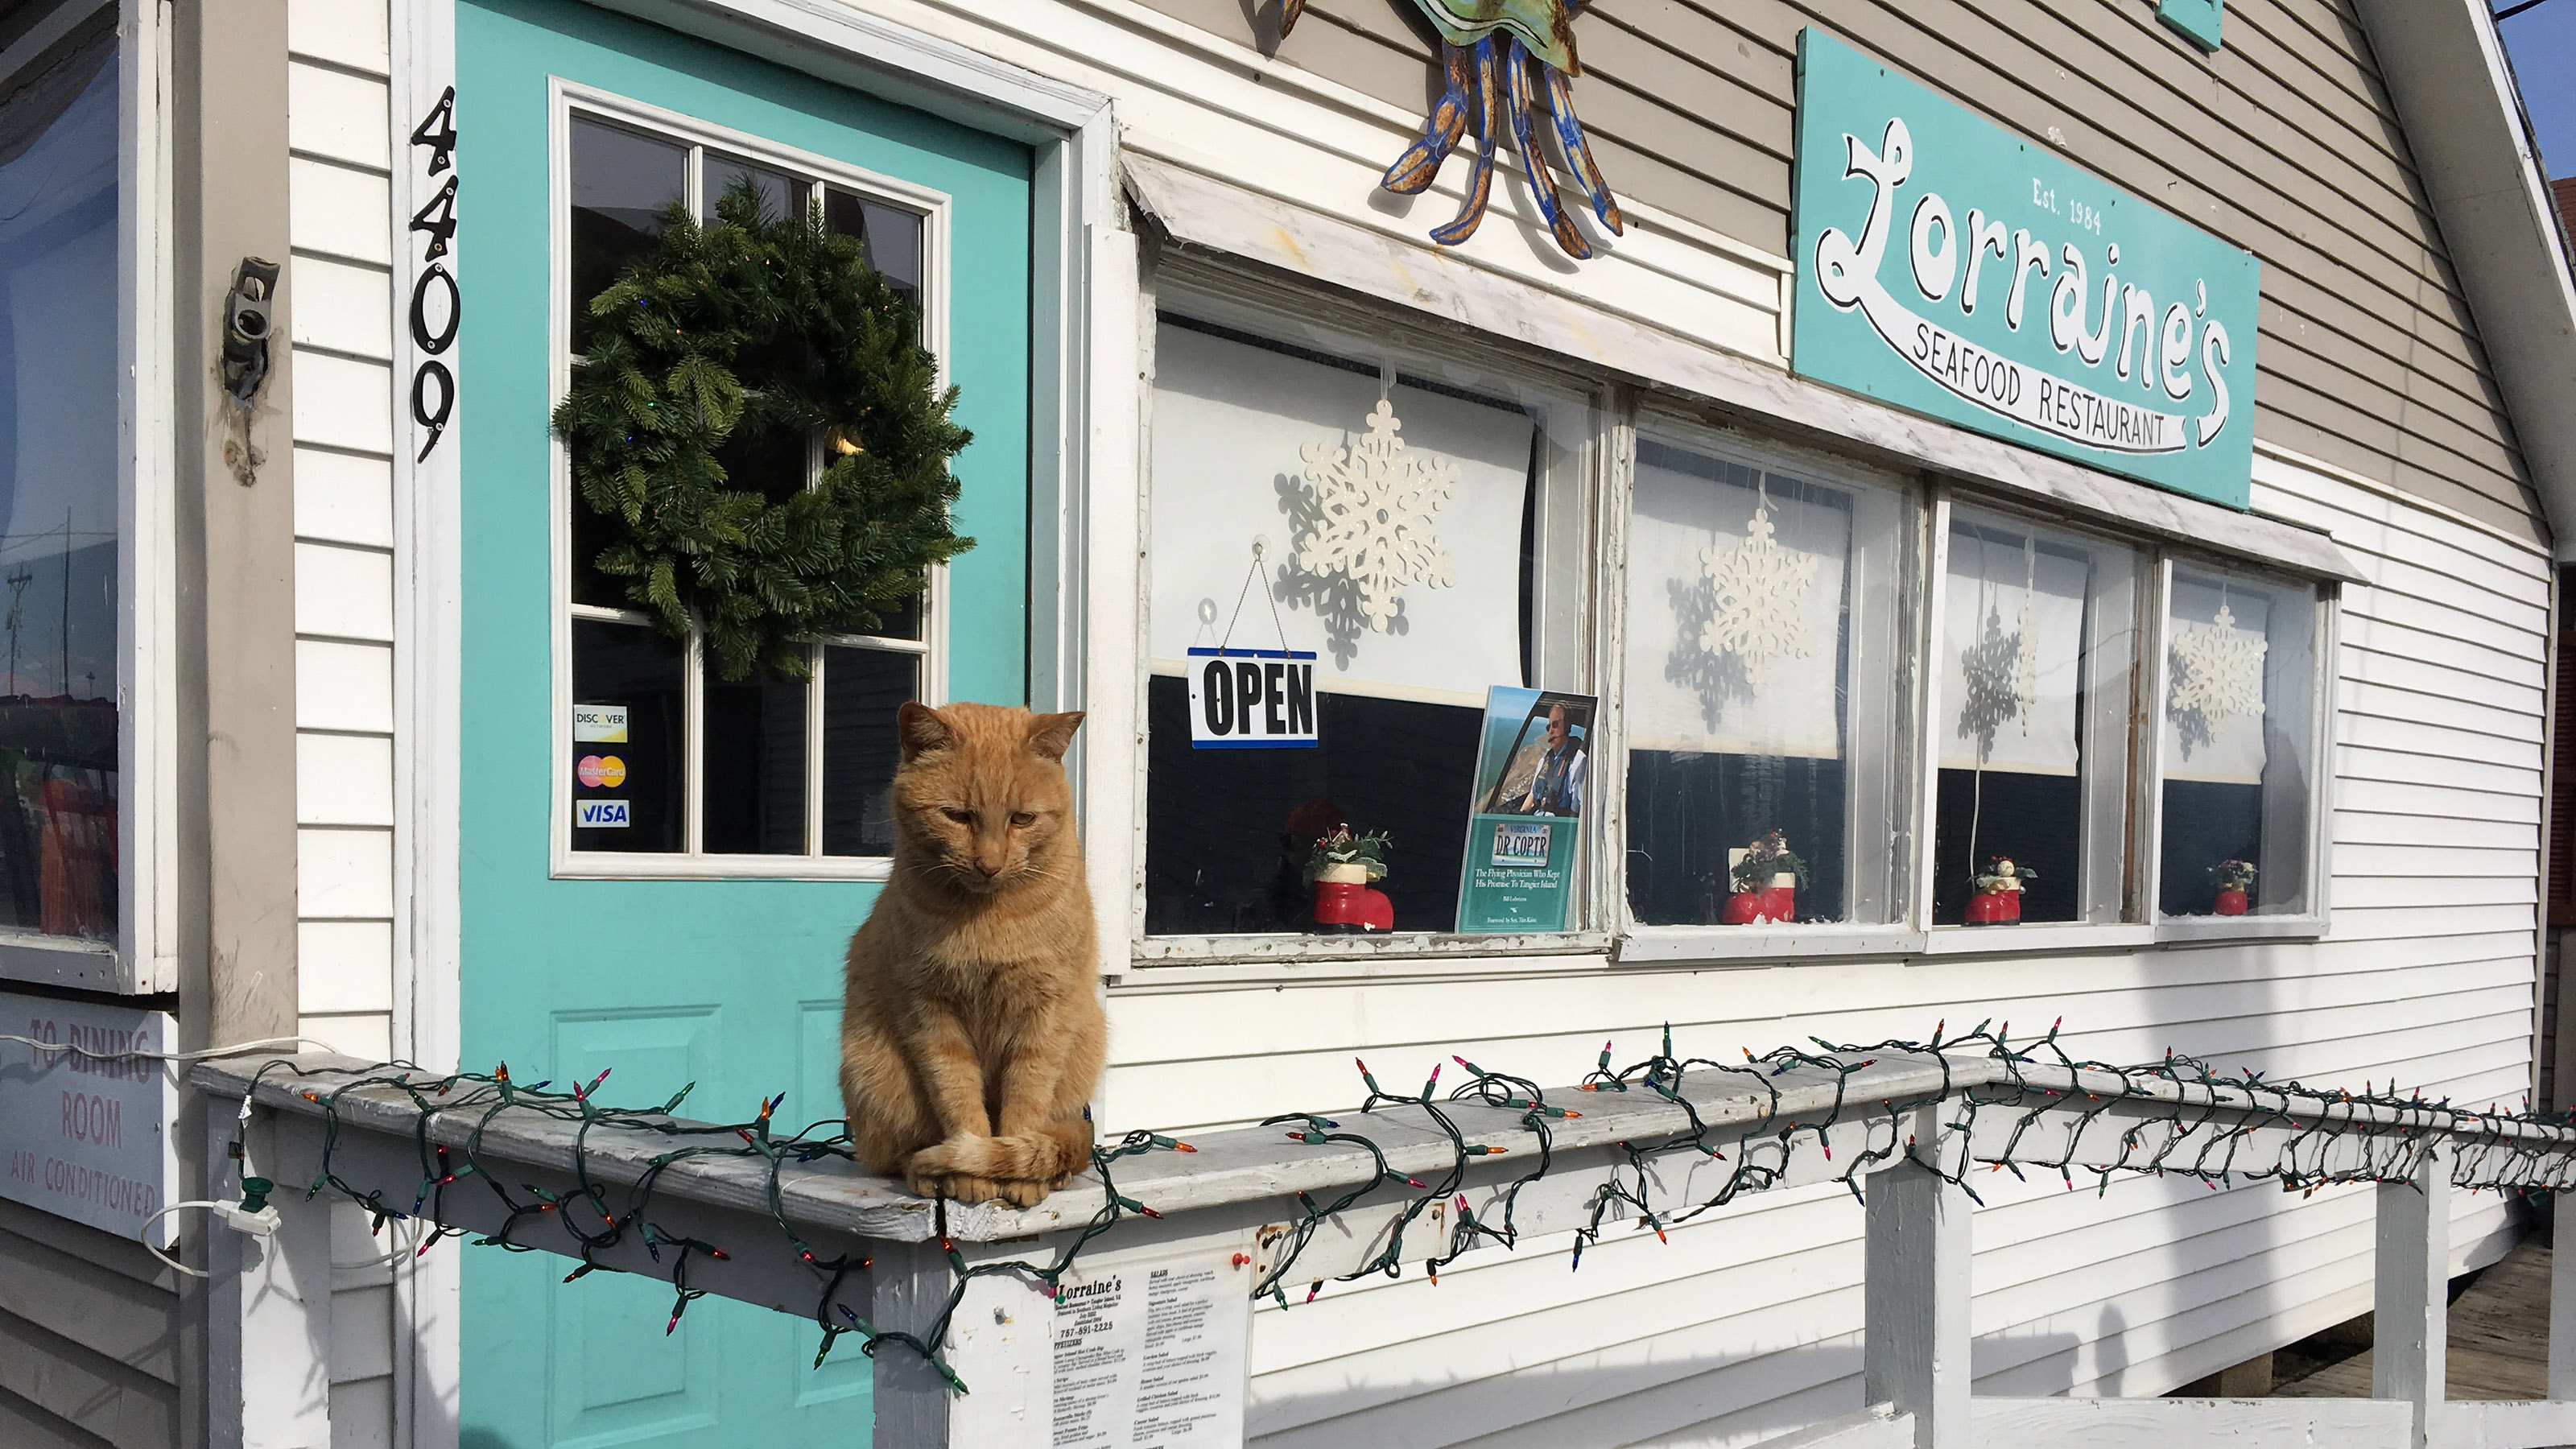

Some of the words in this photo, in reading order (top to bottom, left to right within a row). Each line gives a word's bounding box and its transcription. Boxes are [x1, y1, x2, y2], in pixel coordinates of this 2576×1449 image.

[2031, 177, 2061, 217] Est.
[2069, 198, 2102, 236] 1984
[411, 85, 460, 464] 4409
[1814, 117, 2231, 448] Lorraine's
[1912, 322, 2021, 406] SEAFOOD
[2039, 377, 2165, 446] RESTAURANT
[1203, 659, 1314, 737] OPEN
[579, 766, 625, 777] MasterCard
[581, 804, 627, 823] VISA
[1510, 824, 1537, 834] VIRGINIA
[1475, 869, 1487, 877] The
[1488, 869, 1505, 879] Flying
[1506, 869, 1533, 879] Physician
[1534, 869, 1546, 877] Who
[1546, 869, 1560, 880] Kept
[1495, 835, 1511, 856] DR
[1513, 836, 1547, 857] COPTR
[1475, 879, 1486, 888] His
[1487, 879, 1510, 888] Promise
[1510, 879, 1519, 888] To
[1519, 879, 1540, 890] Tangier
[1540, 880, 1558, 889] Island
[31, 1018, 57, 1069] TO
[69, 1022, 151, 1085] DINING
[61, 1089, 122, 1150] ROOM
[10, 1149, 35, 1184] AIR
[44, 1156, 155, 1218] CONDITIONED
[1060, 1321, 1113, 1338] 757-891-2225
